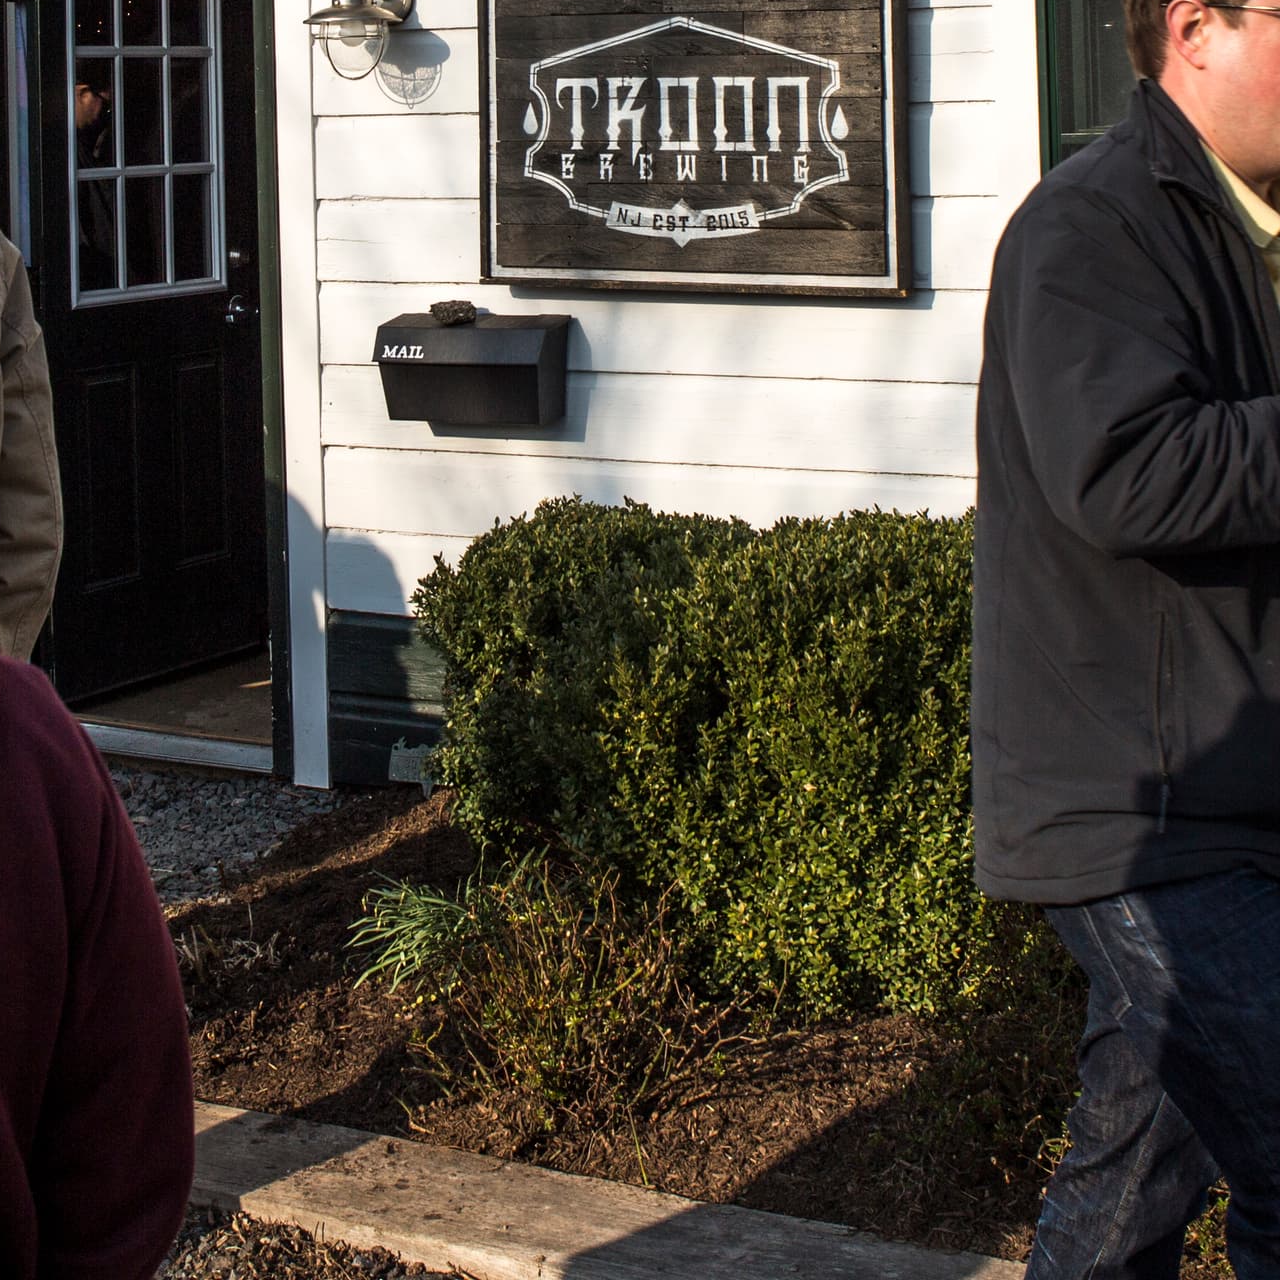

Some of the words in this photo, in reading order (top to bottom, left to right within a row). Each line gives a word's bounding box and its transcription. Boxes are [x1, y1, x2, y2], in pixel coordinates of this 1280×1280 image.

[556, 77, 811, 166] TROON
[561, 153, 810, 185] BREWING
[616, 207, 641, 227] NJ
[707, 210, 750, 232] 2015
[382, 344, 424, 359] MAIL
